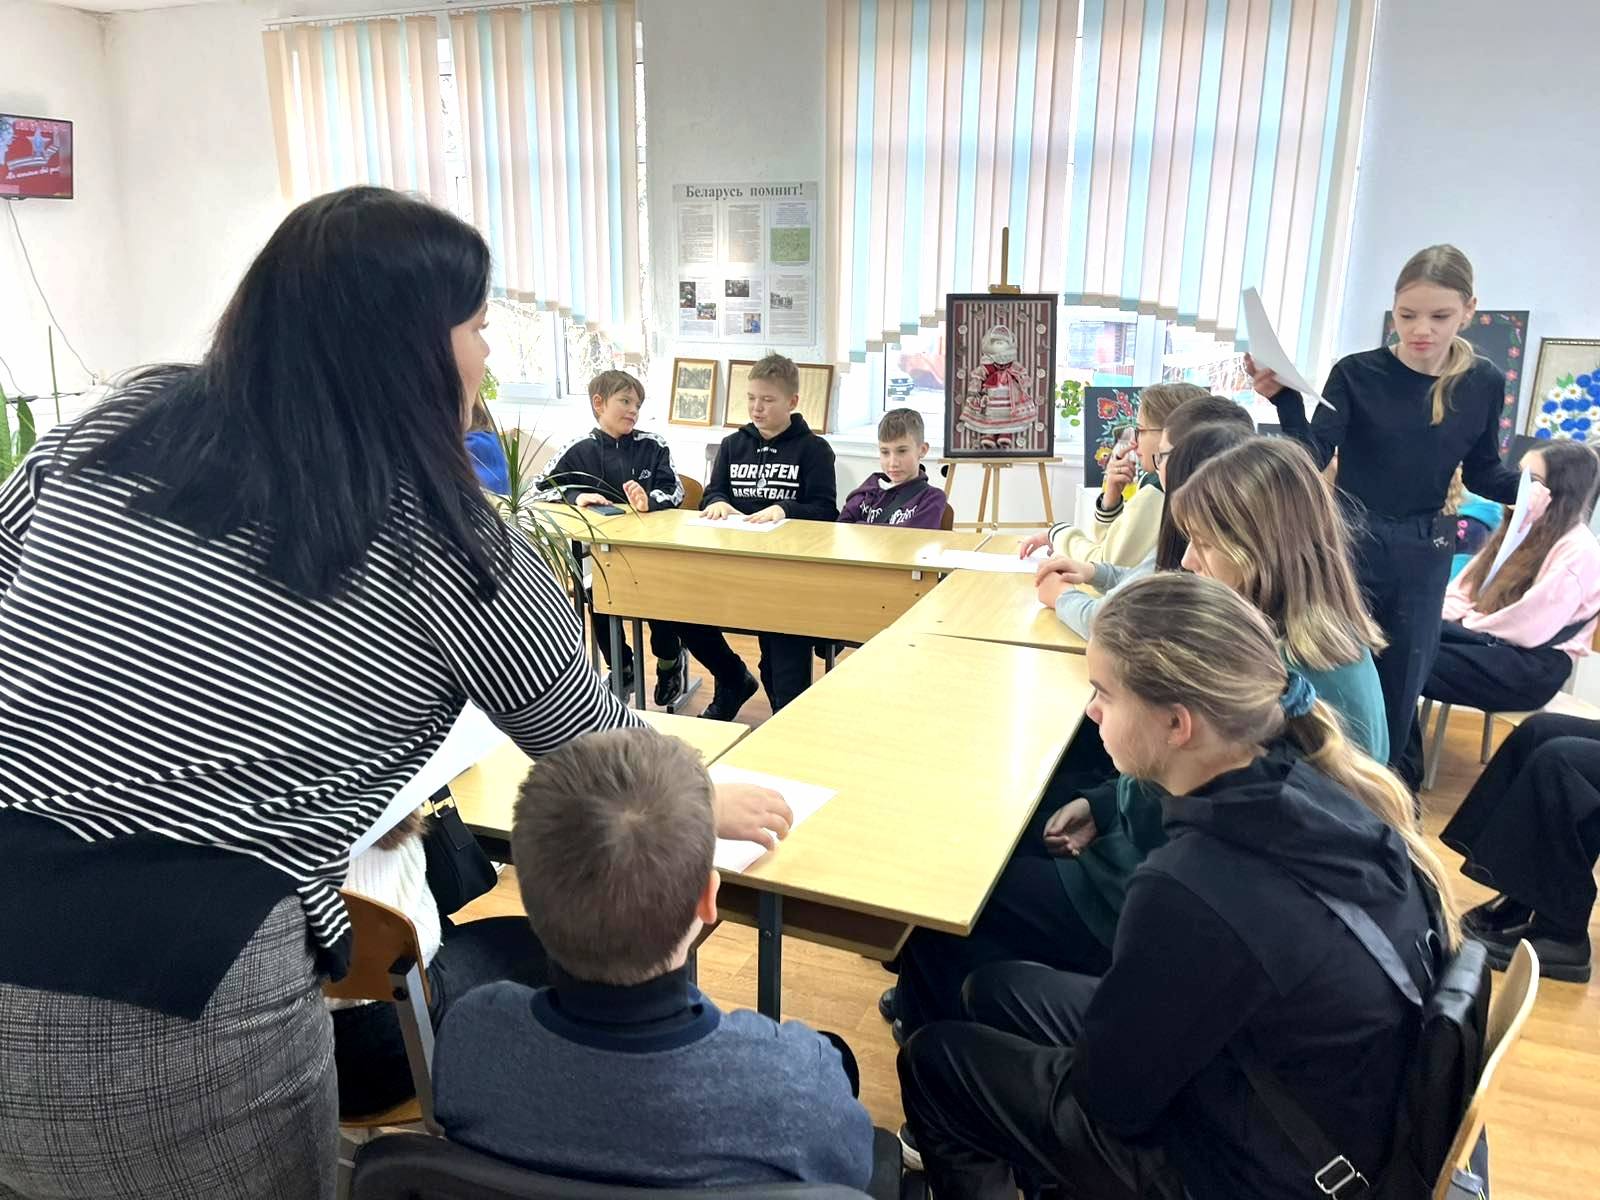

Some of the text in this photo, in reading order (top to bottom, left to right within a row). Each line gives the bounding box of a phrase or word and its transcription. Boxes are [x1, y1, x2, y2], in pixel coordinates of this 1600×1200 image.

[685, 183, 803, 200] Беларусь помнит!
[732, 487, 797, 500] BASKETBALL
